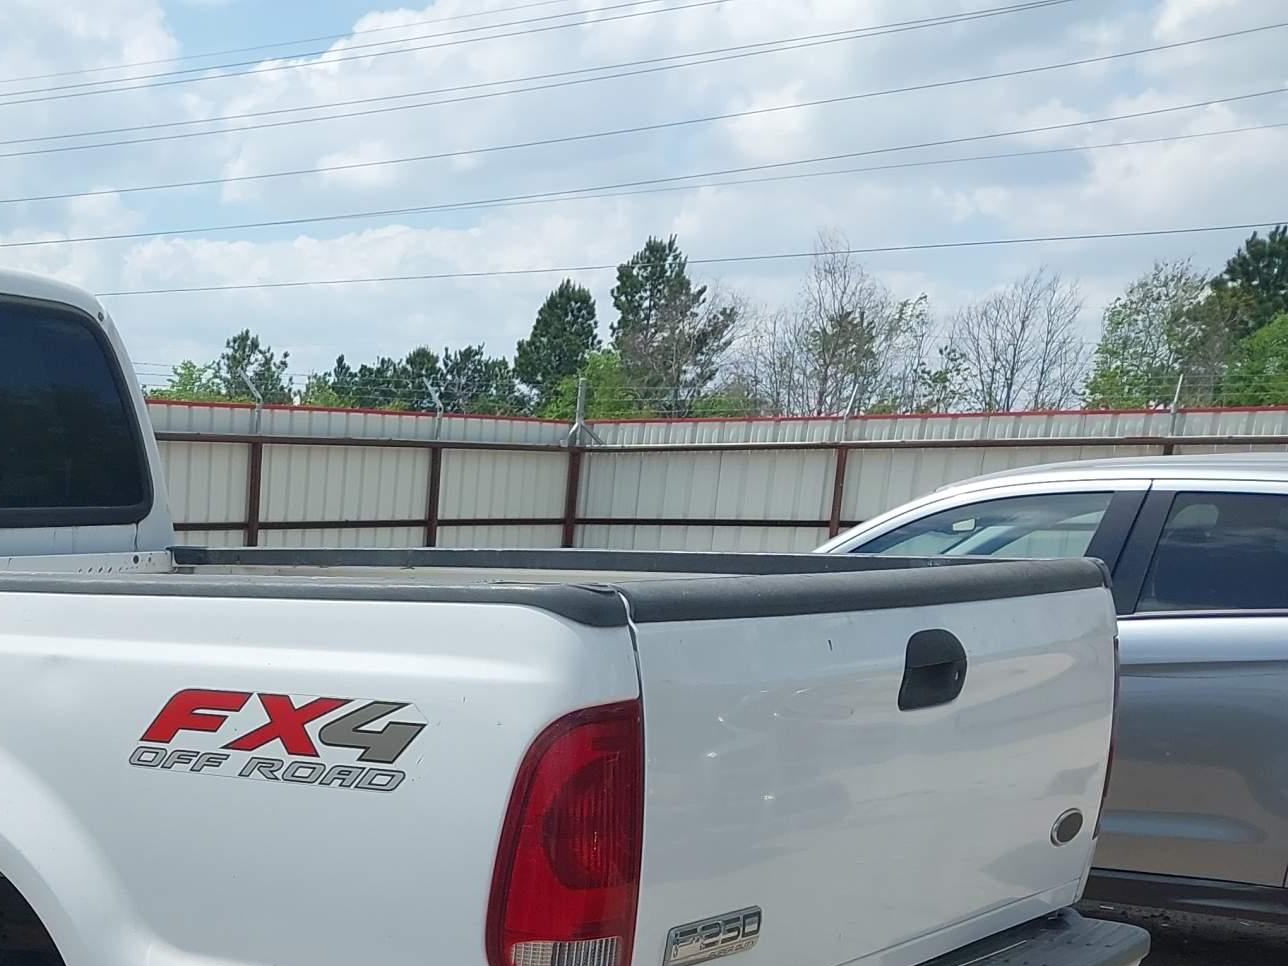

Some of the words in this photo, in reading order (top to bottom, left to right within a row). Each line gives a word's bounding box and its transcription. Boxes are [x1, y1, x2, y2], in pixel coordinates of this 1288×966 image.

[139, 688, 429, 764] FX4
[128, 746, 230, 772] OFF
[238, 756, 406, 791] ROAD
